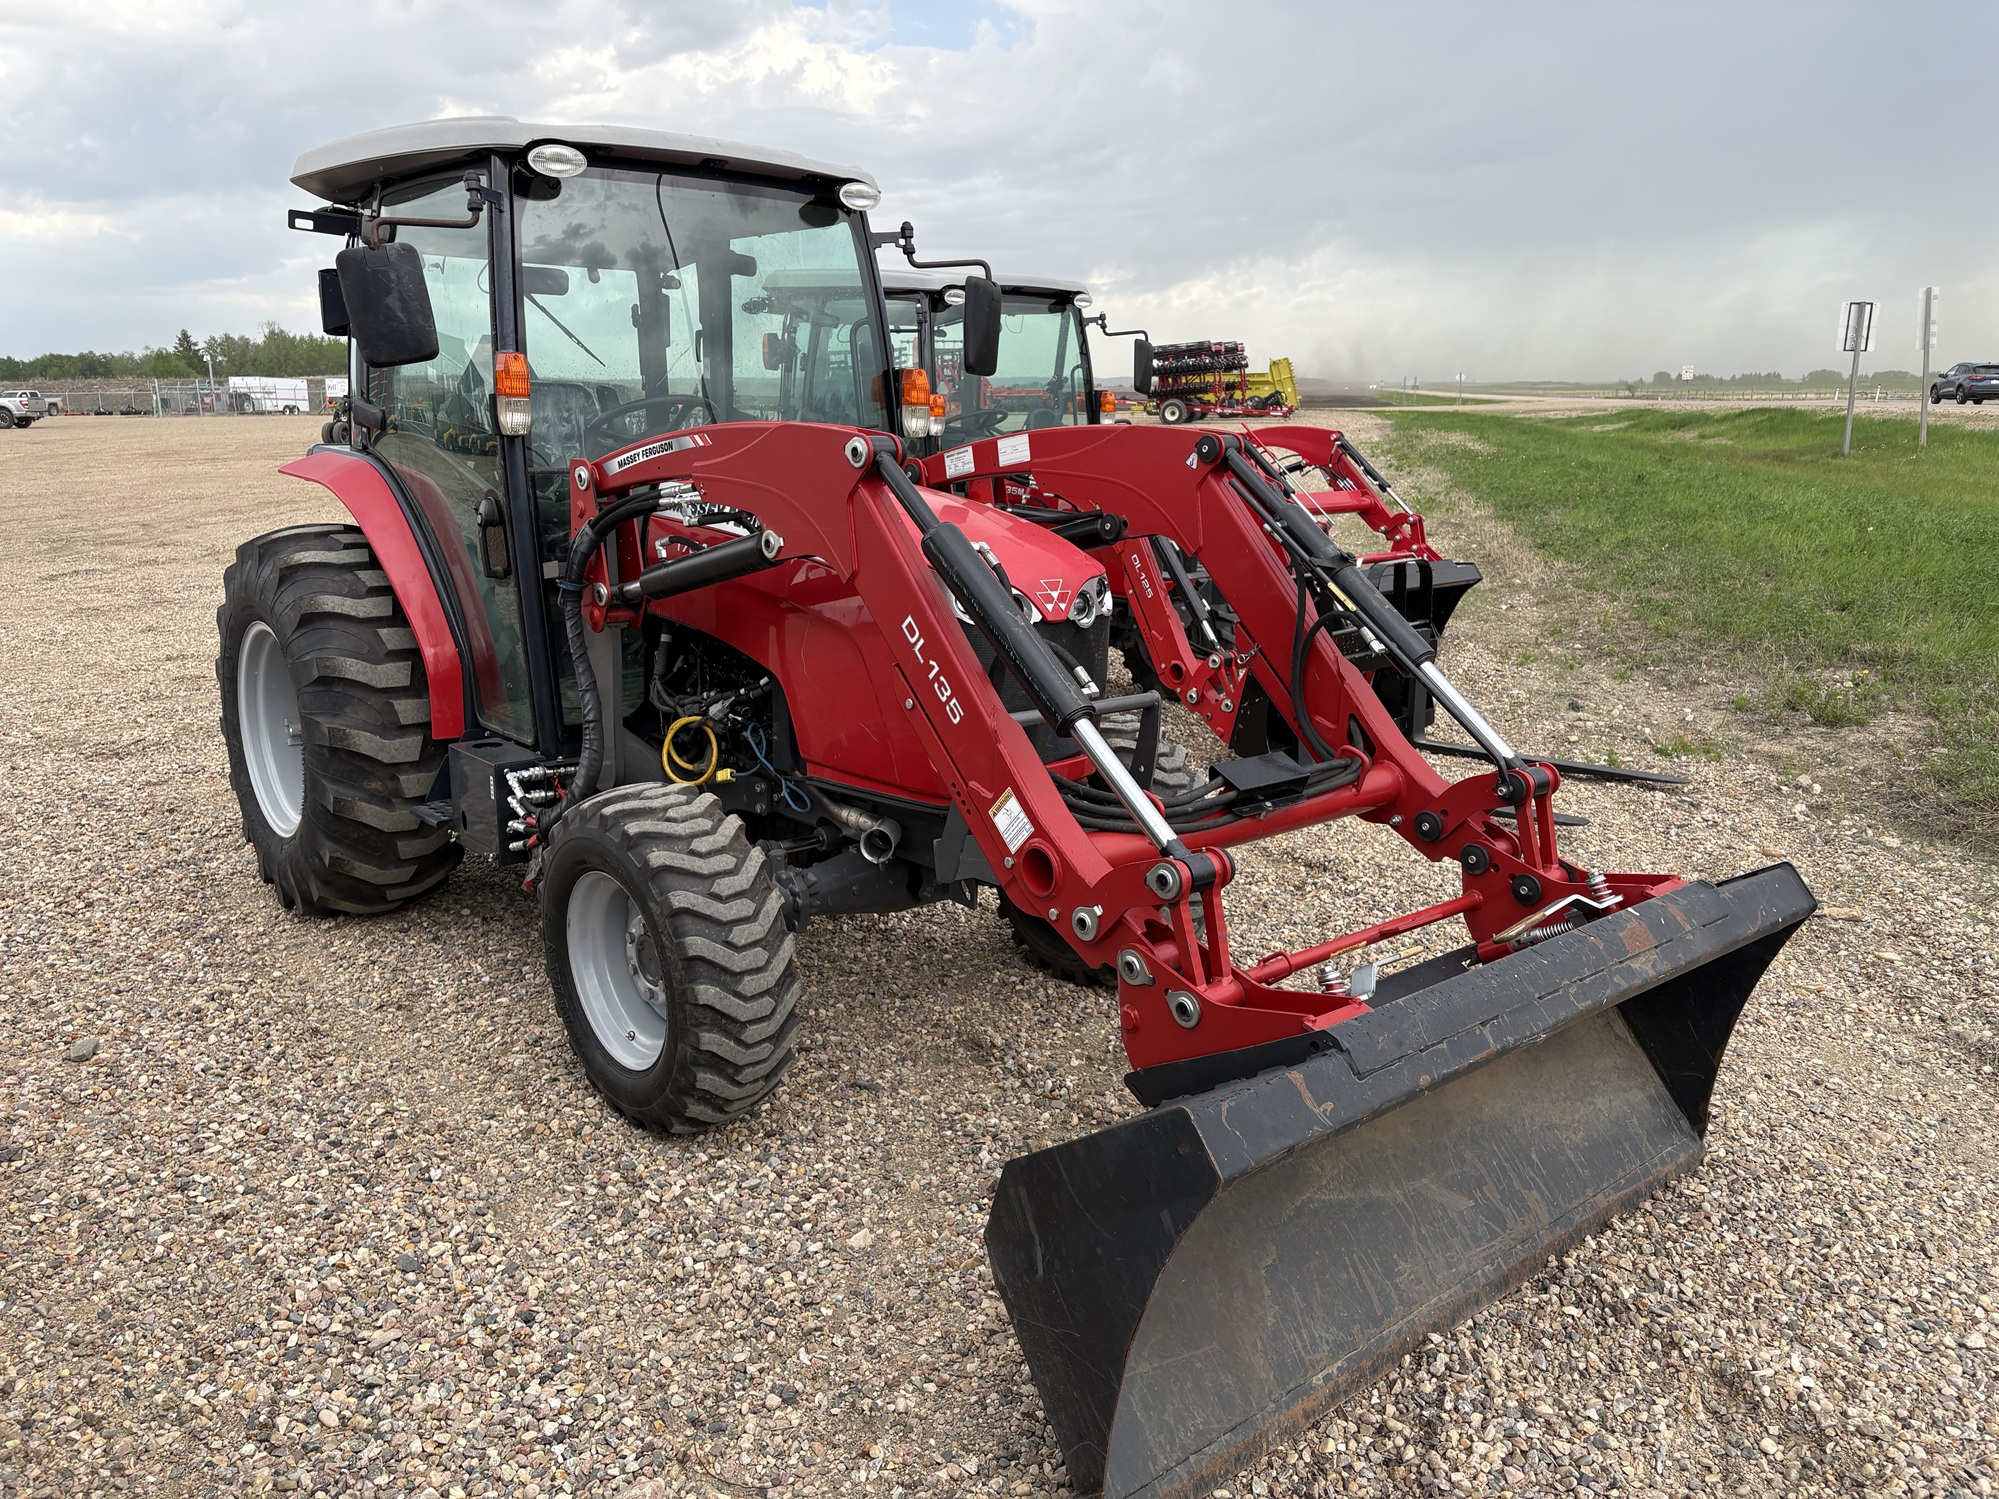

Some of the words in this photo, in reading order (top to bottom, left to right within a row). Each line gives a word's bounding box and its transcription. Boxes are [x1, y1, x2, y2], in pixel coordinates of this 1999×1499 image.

[617, 453, 640, 469] MASSEY
[641, 441, 673, 459] FERGUSON
[1131, 554, 1153, 598] DL125
[901, 614, 964, 725] DL135
